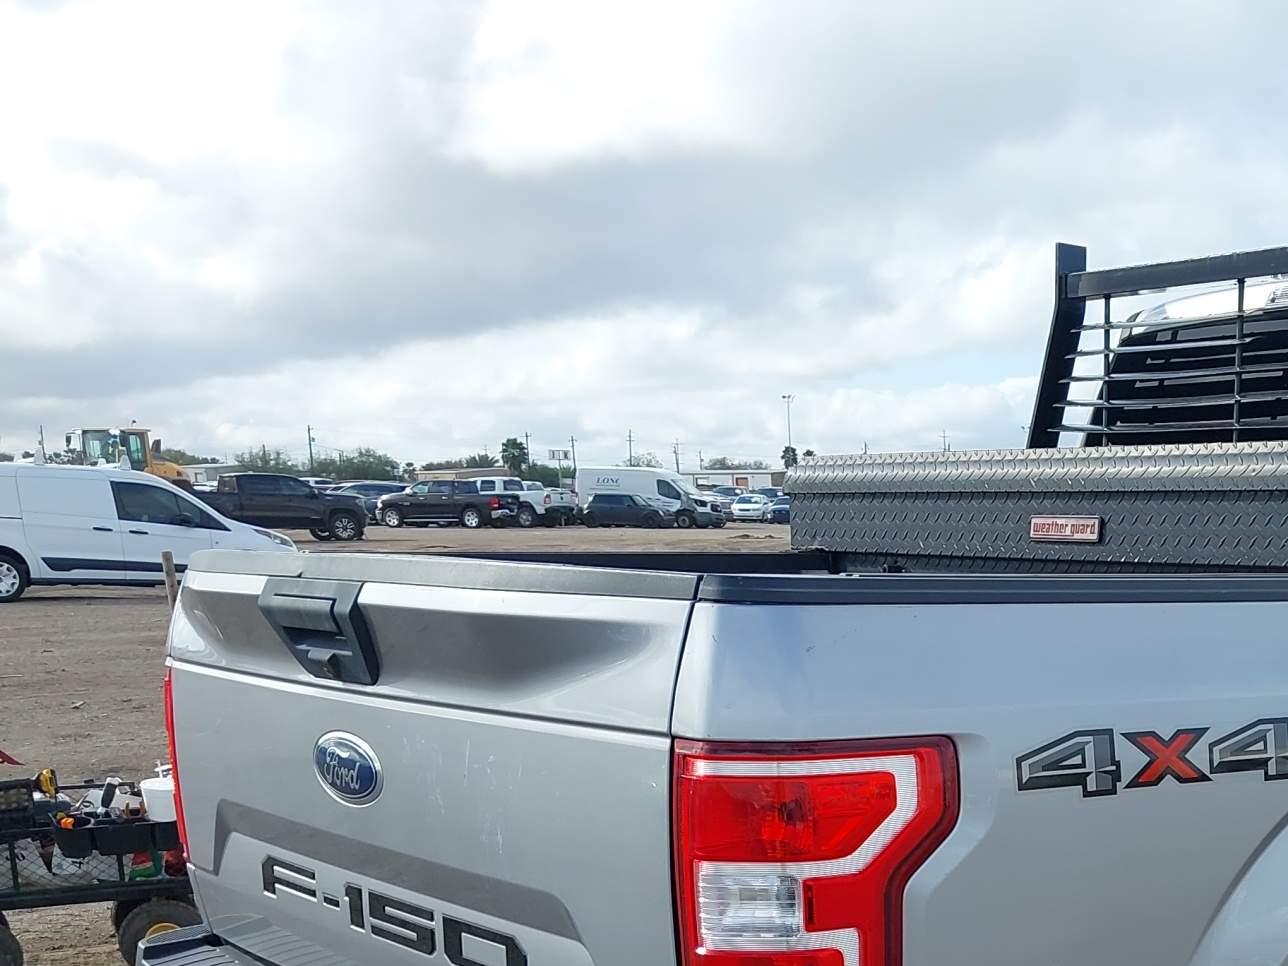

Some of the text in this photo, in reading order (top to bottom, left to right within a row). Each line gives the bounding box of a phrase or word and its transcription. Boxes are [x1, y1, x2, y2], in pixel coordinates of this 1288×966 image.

[1032, 520, 1096, 536] weather guard
[324, 746, 361, 790] Ford
